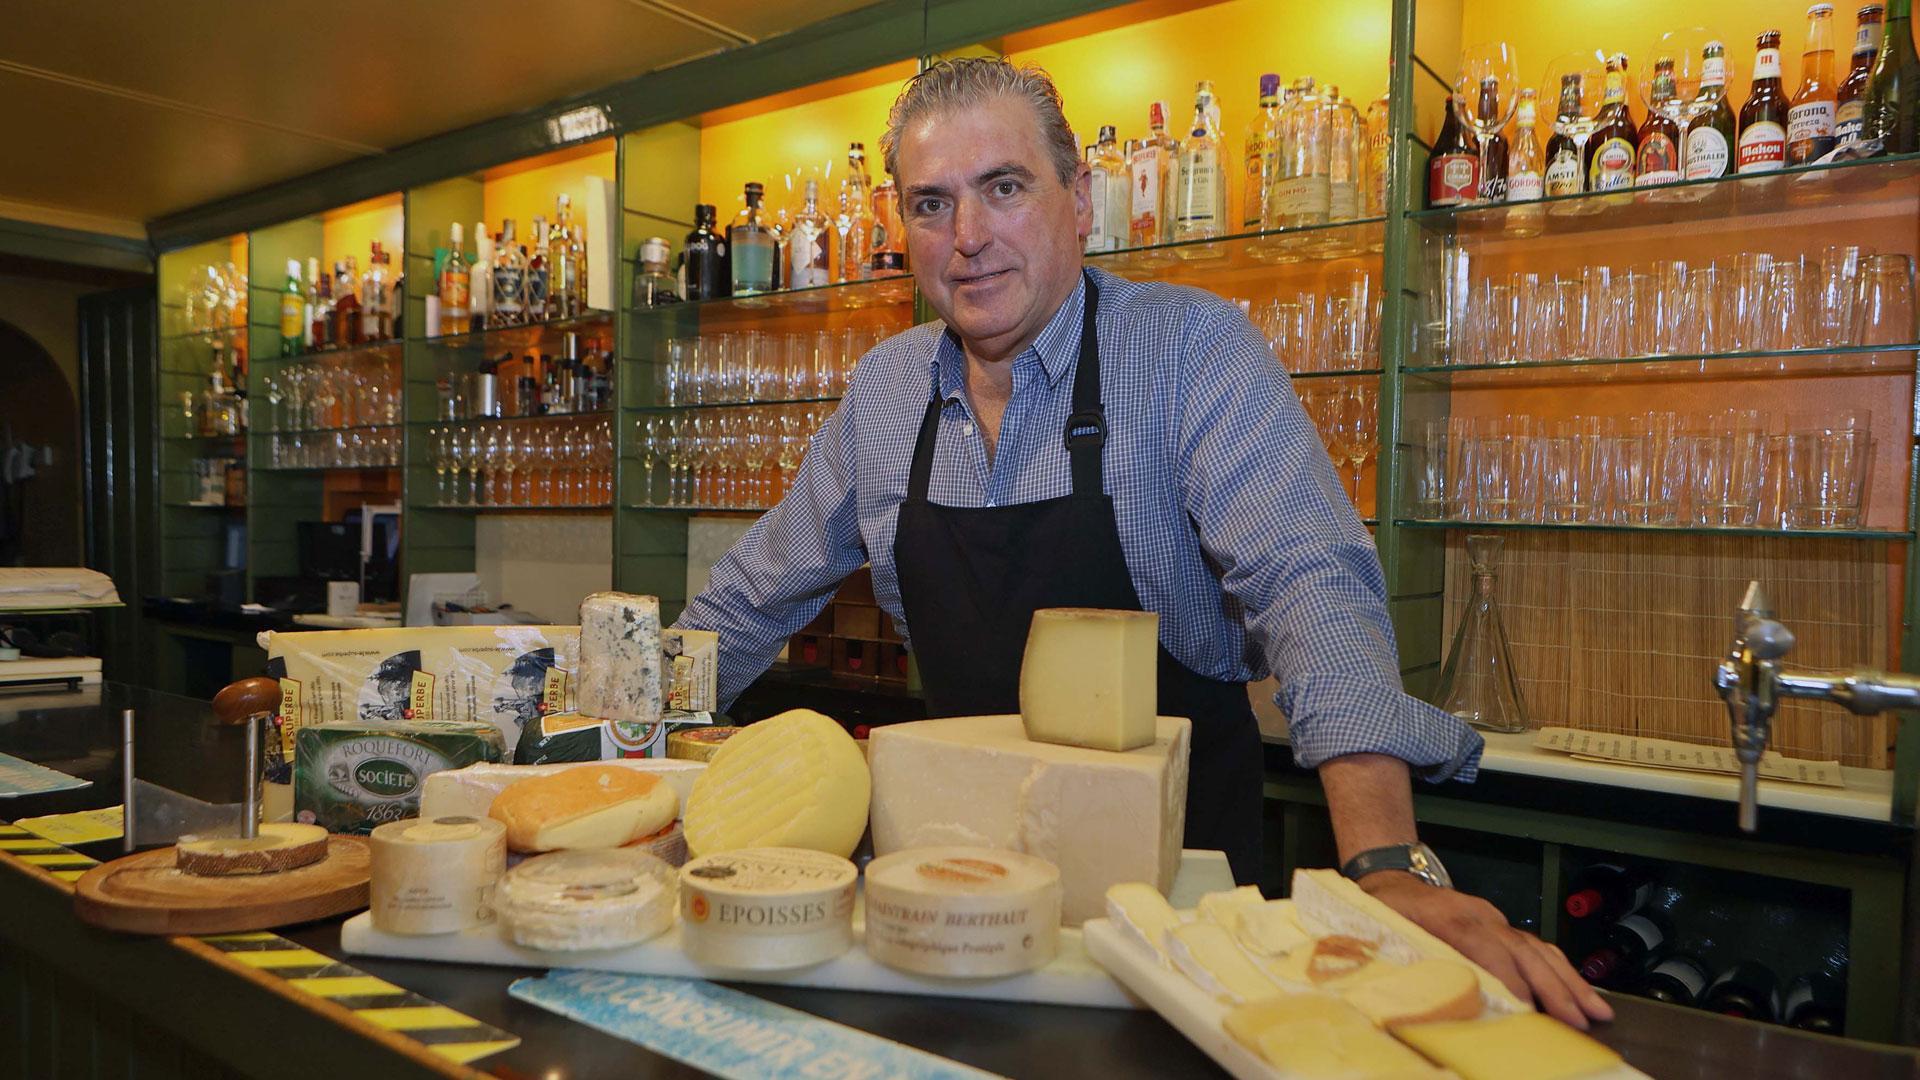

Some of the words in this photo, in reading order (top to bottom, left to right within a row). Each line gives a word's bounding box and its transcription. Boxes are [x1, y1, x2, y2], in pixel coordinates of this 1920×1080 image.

[1787, 105, 1827, 123] Corona
[1835, 122, 1863, 136] Maho
[1742, 144, 1781, 158] Mahou
[284, 688, 294, 737] SUPERBE
[342, 740, 433, 765] ROQUEFORT
[719, 901, 827, 926] EPOISSES
[945, 909, 1029, 928] BERTHAUT
[608, 985, 816, 1067] CONSUMIR
